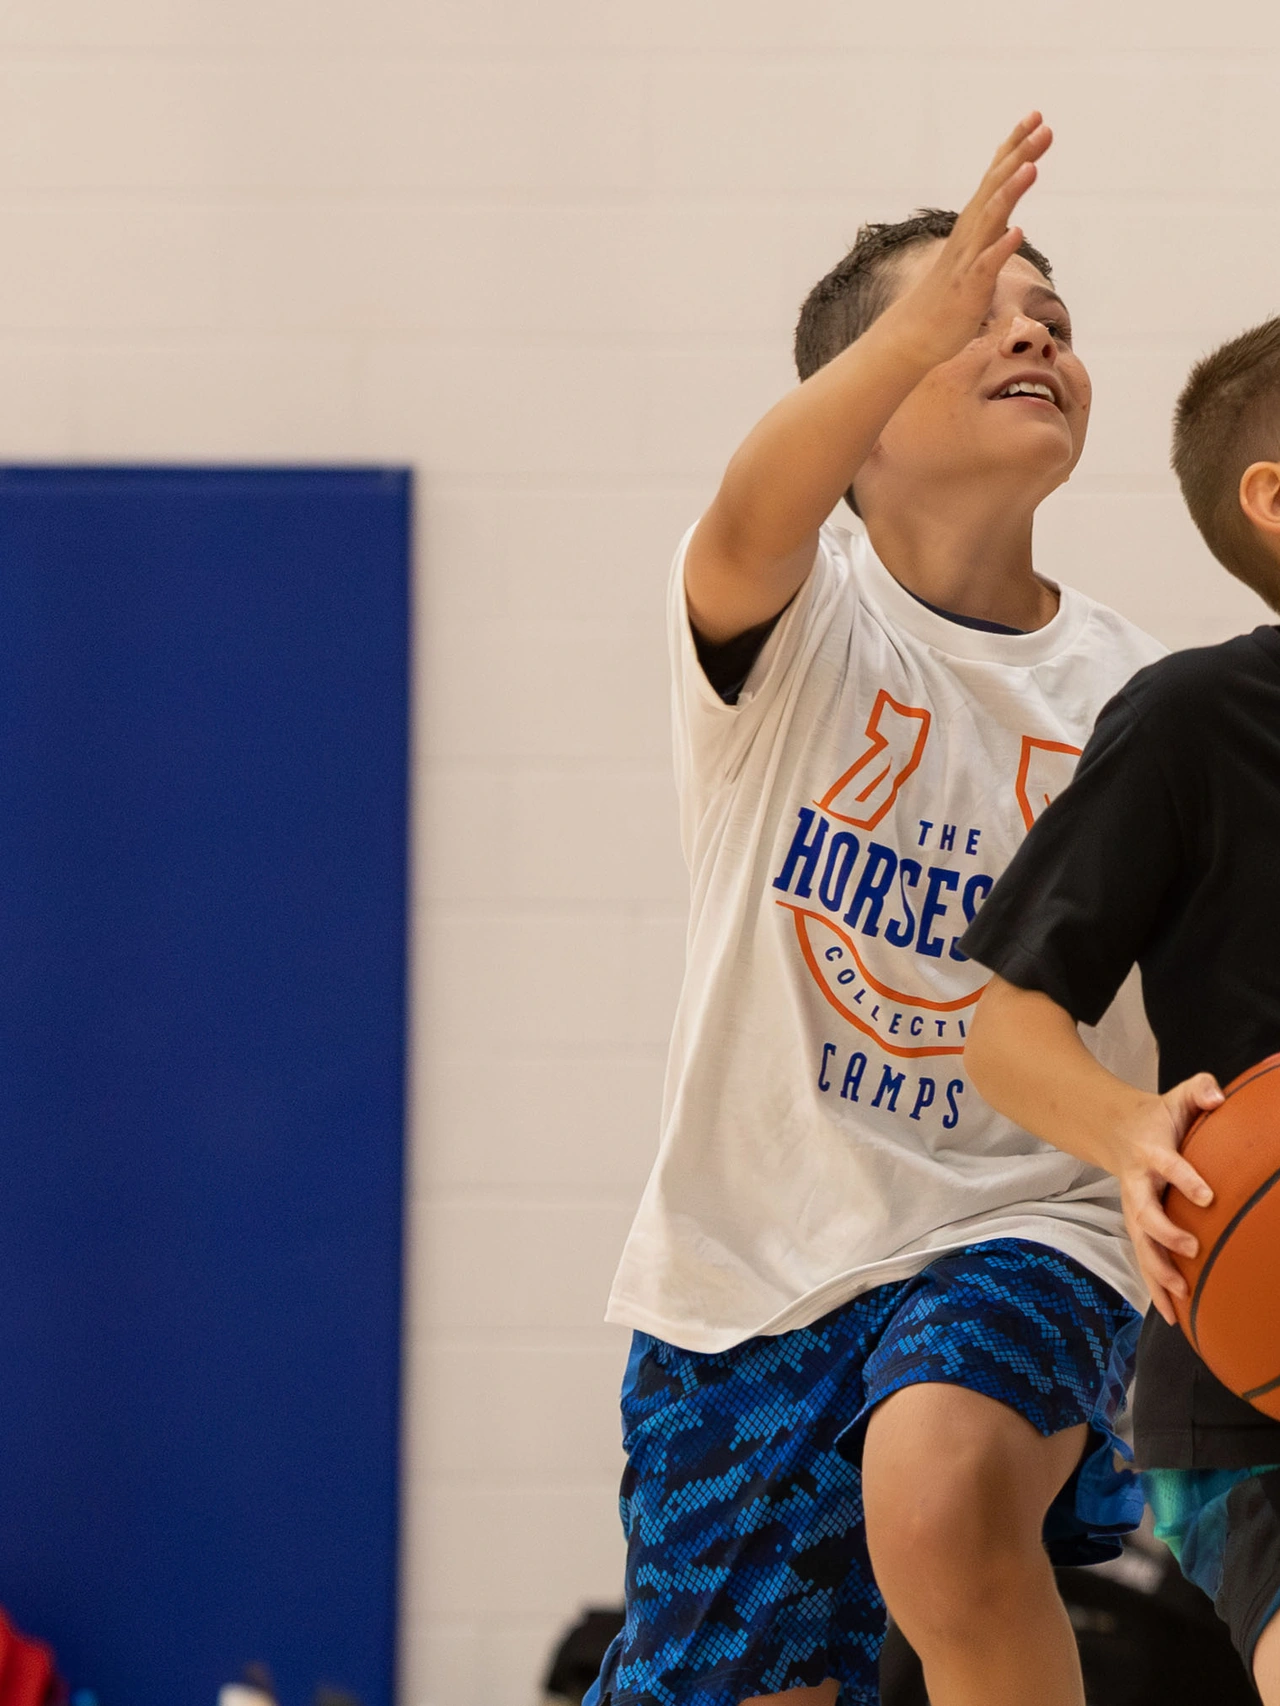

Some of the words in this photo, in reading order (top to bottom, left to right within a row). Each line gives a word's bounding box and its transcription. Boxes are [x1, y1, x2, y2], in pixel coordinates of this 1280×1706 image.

[917, 819, 981, 856] THE
[824, 945, 966, 1038] COLLECTI
[817, 1042, 964, 1130] CAMPS
